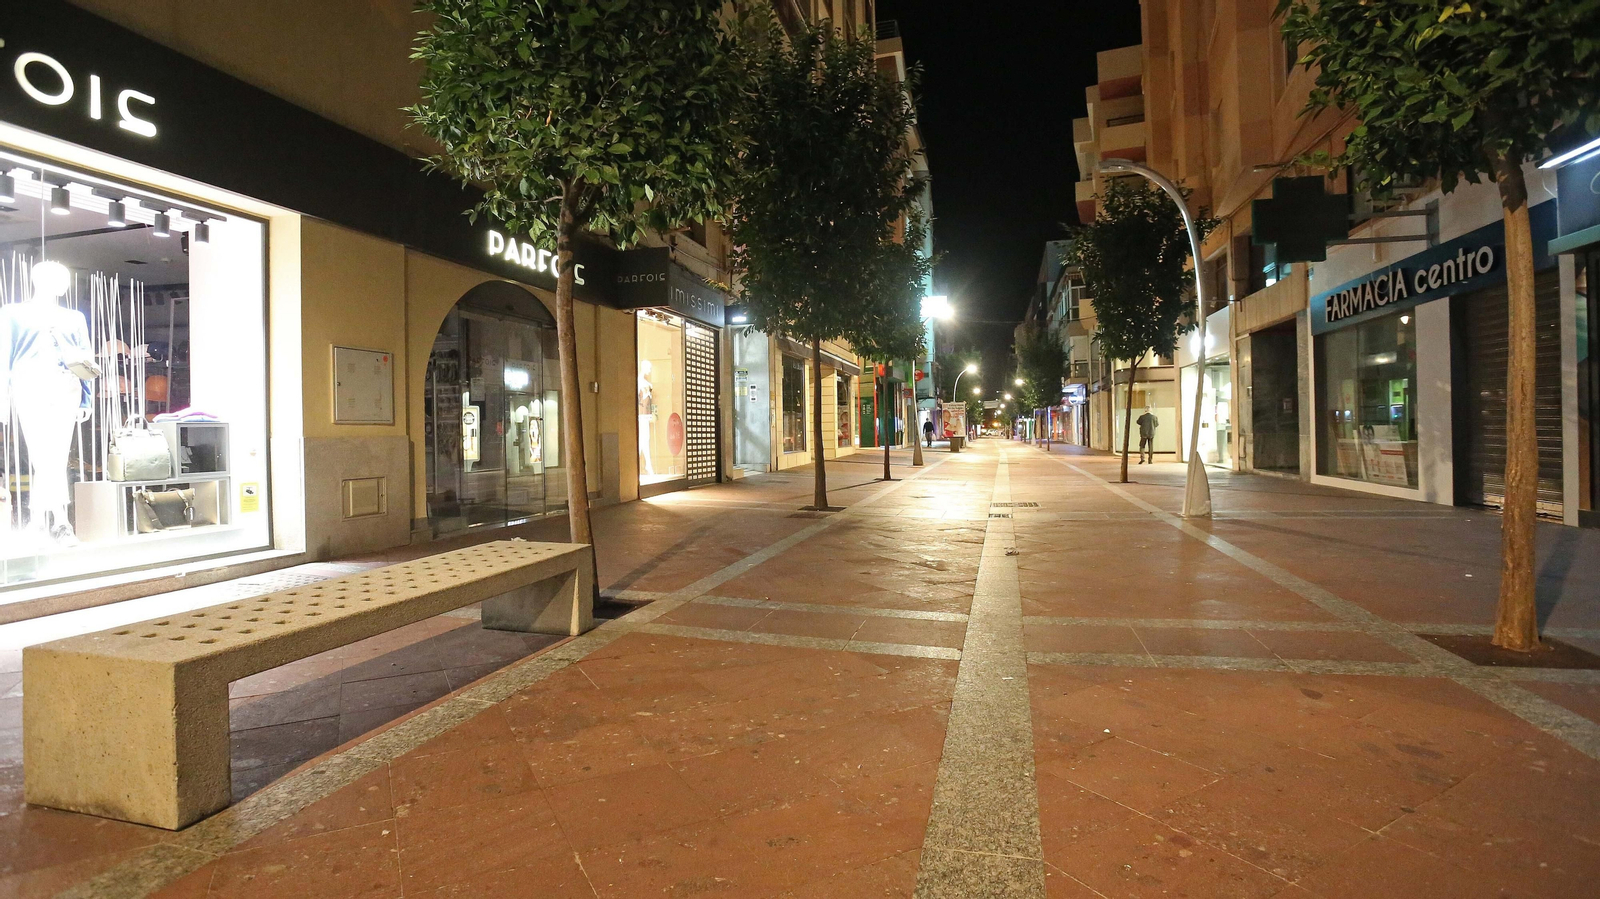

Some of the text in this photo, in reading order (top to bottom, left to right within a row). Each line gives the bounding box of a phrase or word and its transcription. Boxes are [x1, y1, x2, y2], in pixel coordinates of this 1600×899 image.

[0, 38, 157, 137] OIS
[489, 229, 585, 286] PARFOS
[617, 272, 666, 284] PARFOIS
[1325, 245, 1494, 323] FARMACIA centro
